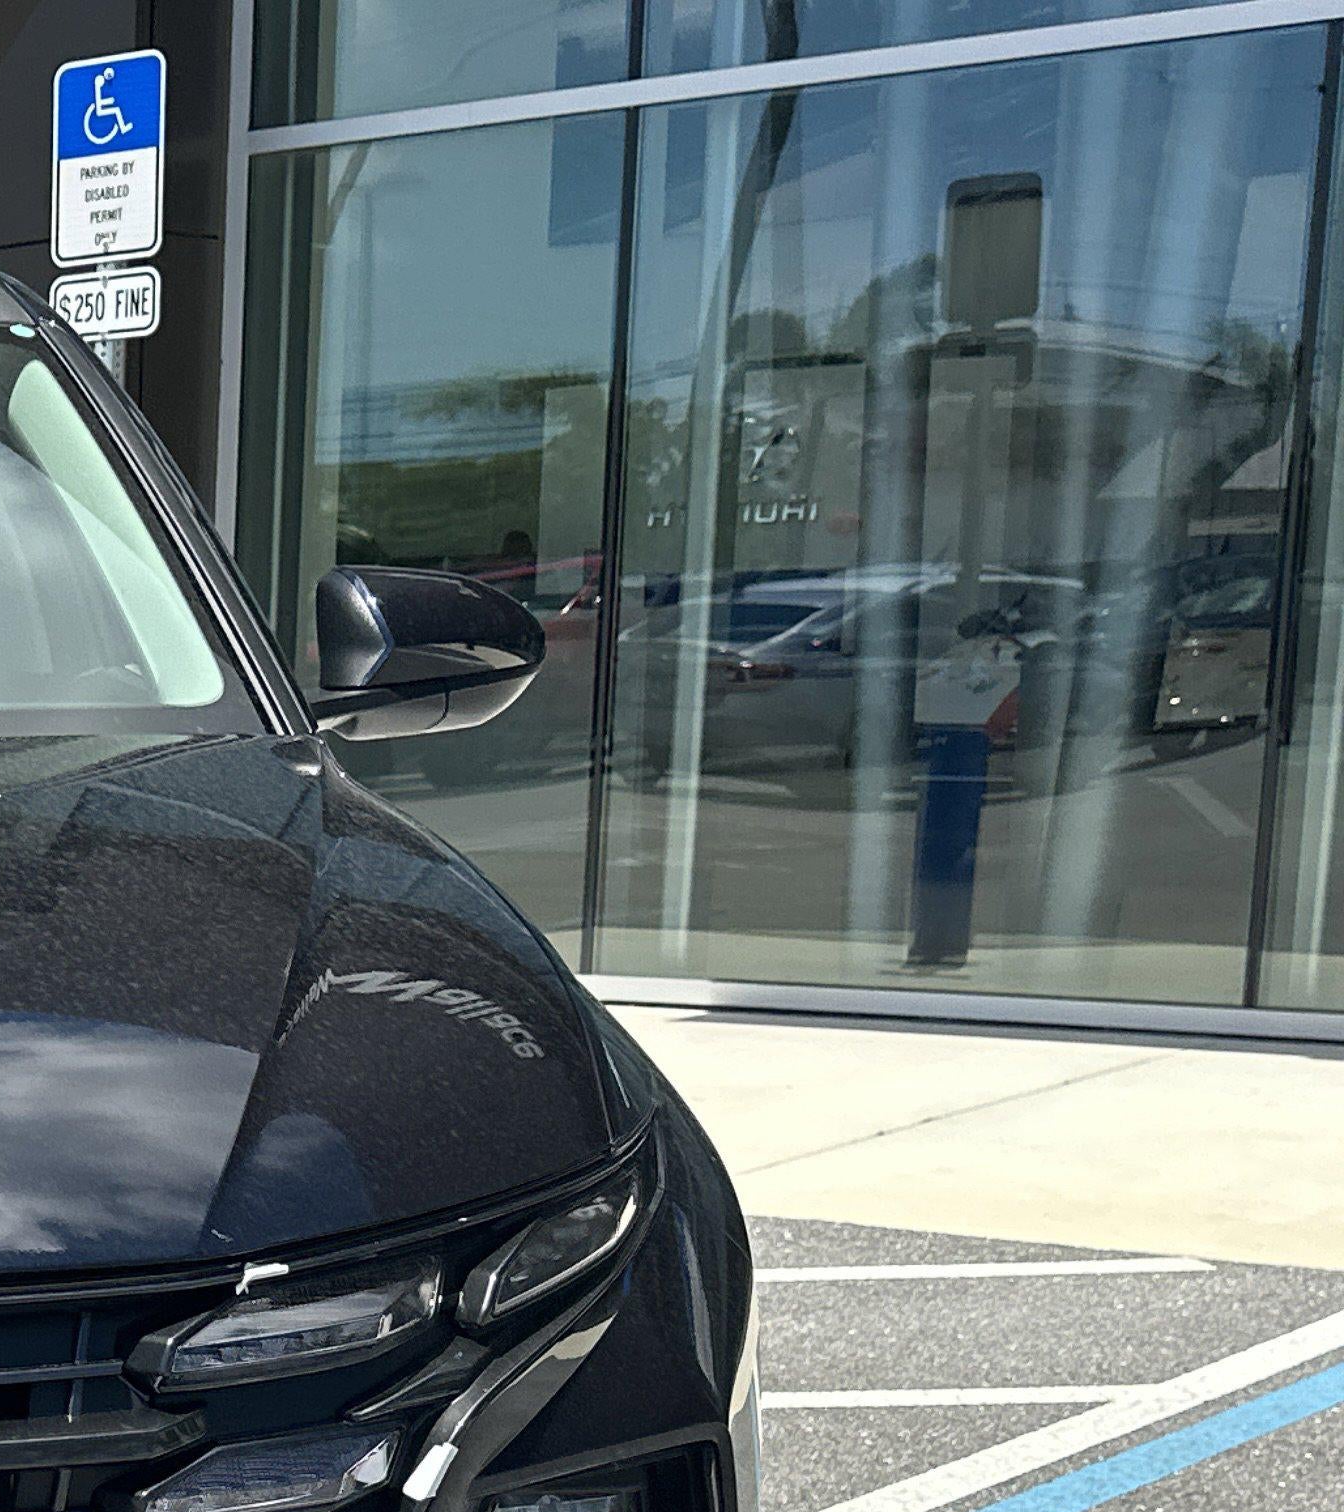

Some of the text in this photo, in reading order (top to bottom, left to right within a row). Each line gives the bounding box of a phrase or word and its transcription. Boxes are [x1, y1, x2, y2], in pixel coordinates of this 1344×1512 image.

[80, 160, 135, 180] PARKING BY
[85, 184, 130, 203] DISABLED
[90, 207, 122, 224] PERMIT
[60, 287, 150, 323] $250 FINE
